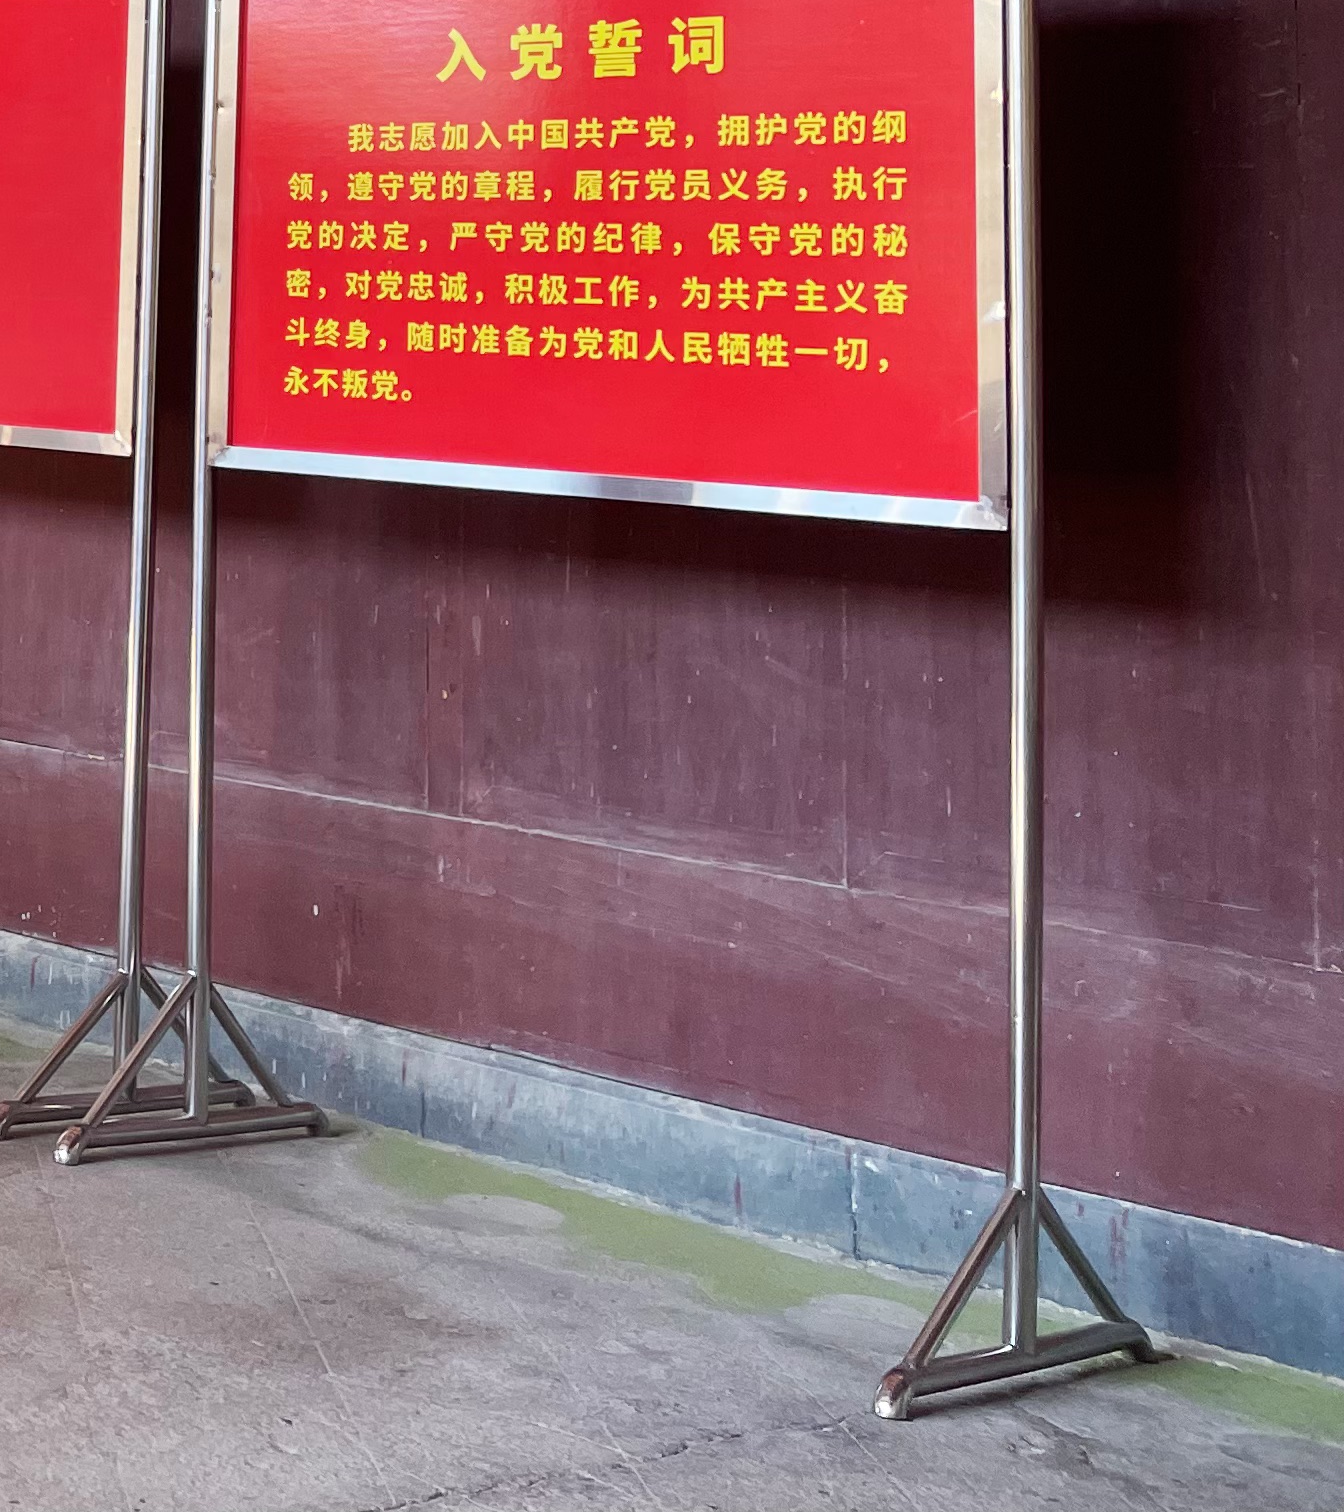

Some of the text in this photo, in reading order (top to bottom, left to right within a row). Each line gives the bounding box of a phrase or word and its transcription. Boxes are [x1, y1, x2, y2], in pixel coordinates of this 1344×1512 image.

[435, 15, 726, 84] 入党誓词
[348, 110, 907, 153] 我志愿加入中国共产党，拥护党的纲
[288, 165, 908, 203] 领，遵守党的章程，履行党员义务，执行
[286, 219, 909, 258] 党的决定，严守党的纪律，保守党的秘
[285, 268, 909, 315] 密，对党忠诚，积极工作，为共产主义奋
[283, 317, 890, 374] 斗终身，随时准备为党和人民牺牲一切，
[283, 366, 413, 402] 永不叛党。
